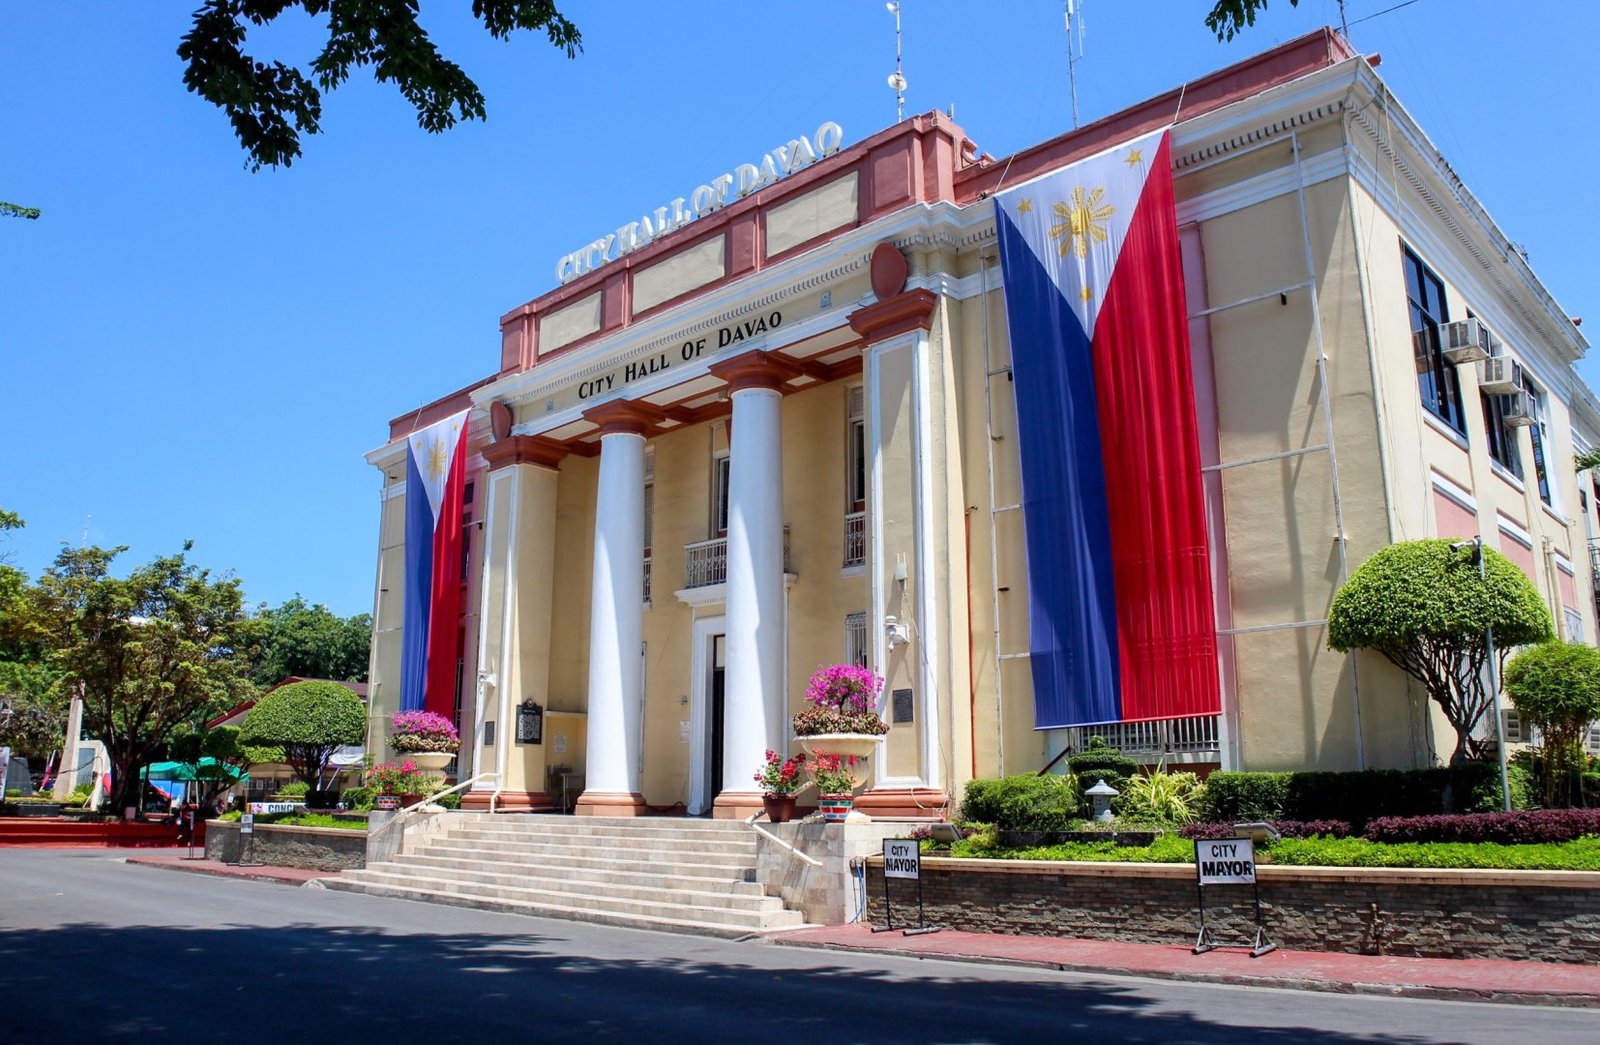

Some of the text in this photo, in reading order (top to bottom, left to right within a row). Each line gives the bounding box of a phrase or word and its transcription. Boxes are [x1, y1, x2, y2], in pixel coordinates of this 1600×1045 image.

[556, 121, 843, 283] CITY HALL OF DAVAO
[578, 311, 782, 399] CITY HALL OF DAVAO
[891, 845, 910, 856] CITY
[1211, 844, 1237, 858] CITY
[885, 858, 917, 873] MAYOR
[1202, 860, 1253, 877] MAYOR
